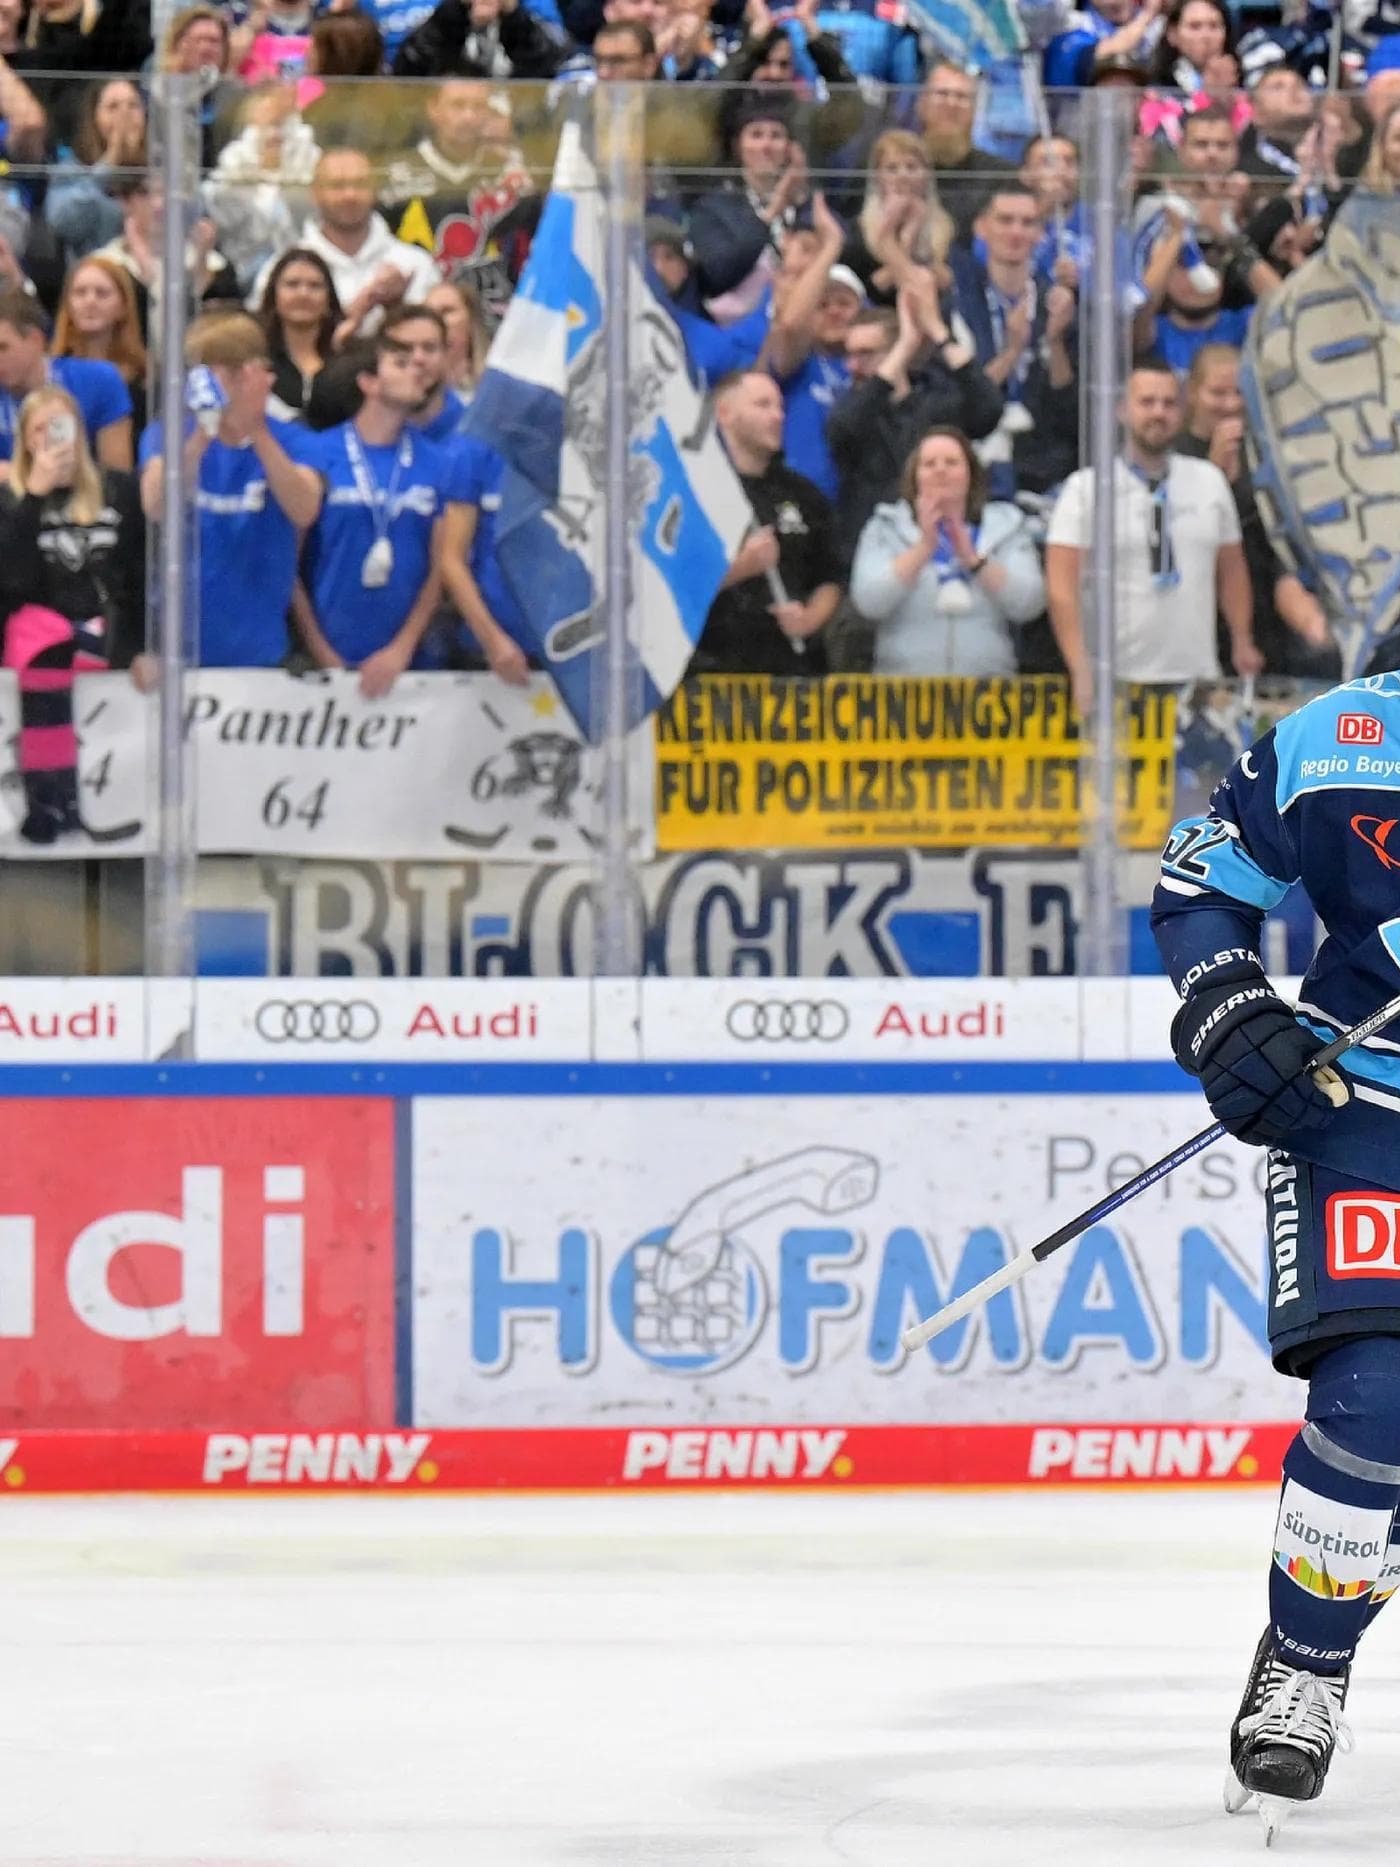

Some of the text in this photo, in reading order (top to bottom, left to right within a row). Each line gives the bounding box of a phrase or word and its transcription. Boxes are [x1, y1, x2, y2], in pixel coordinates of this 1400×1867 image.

[184, 694, 417, 753] Panther
[657, 677, 1175, 743] KENNZEICHNUNGSPFLHT
[1340, 716, 1380, 742] DB
[659, 743, 740, 814] FÜR
[757, 757, 1004, 813] POLIZISTEN
[1020, 756, 1146, 810] JETT
[1300, 754, 1349, 779] Regio
[262, 777, 331, 831] 64
[407, 1003, 539, 1039] Audi
[873, 1003, 1005, 1039] Audi
[1269, 1149, 1300, 1308] ATURN
[1284, 1637, 1351, 1660] BAUER
